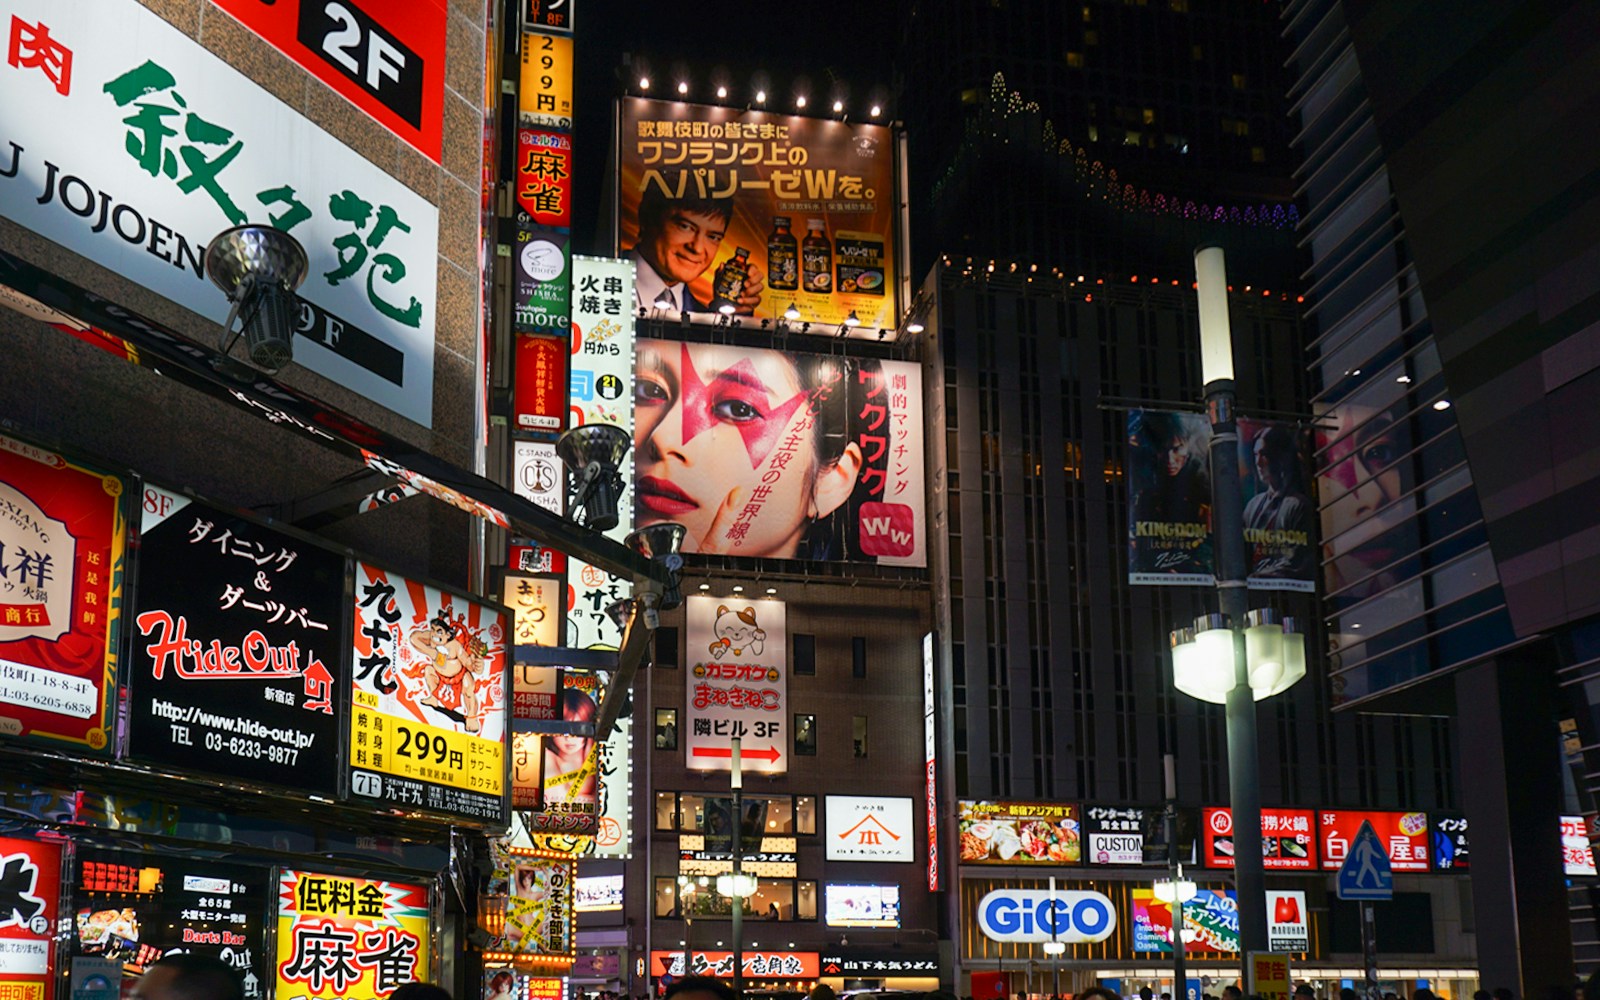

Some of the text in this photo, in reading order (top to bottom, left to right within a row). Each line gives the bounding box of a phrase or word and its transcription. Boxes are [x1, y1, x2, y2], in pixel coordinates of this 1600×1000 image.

[8, 14, 73, 96] 肉
[322, 2, 405, 90] 2F
[537, 36, 556, 111] 299円
[637, 120, 790, 141] 歌舞伎町の皆さまに
[637, 141, 808, 166] ワンランク上の
[522, 151, 568, 215] 麻雀
[638, 168, 876, 200] ヘパリーゼWを。
[517, 231, 532, 241] 5F
[515, 311, 569, 328] more
[584, 342, 621, 356] 円から
[858, 369, 888, 497] ワクワク
[891, 373, 911, 496] 劇的マッチング
[143, 488, 175, 518] 8F
[1135, 521, 1207, 539] KINGDOM
[188, 517, 299, 573] ダイニング
[0, 541, 55, 589] 祥
[253, 570, 273, 592] &
[5, 606, 42, 625] 商行
[219, 583, 330, 632] ダーツバー
[574, 608, 583, 618] 円
[583, 588, 608, 641] サワー
[356, 578, 403, 696] 九十九
[0, 664, 91, 695] 伎町1-18-8-4F
[705, 661, 768, 682] カラオケ
[264, 685, 297, 707] 新宿店
[693, 683, 781, 712] まねきねこ
[151, 698, 316, 749] http://www.hide-out.jp/
[694, 718, 781, 739] 隣ビル 3F
[170, 723, 299, 767] TEL 03-6233-9877
[396, 726, 464, 771] 299円
[469, 742, 501, 759] 生ビール
[470, 759, 492, 772] サワー
[355, 773, 382, 797] 7F
[469, 775, 500, 792] カクテル
[385, 784, 424, 806] 九十九
[535, 814, 595, 829] マドンナ
[1322, 813, 1336, 826] 5F
[1326, 830, 1414, 861] 白屋
[1438, 857, 1453, 869] 4F
[298, 876, 385, 918] 低料金
[985, 897, 1110, 936] GiGO
[1135, 914, 1150, 923] Get
[1153, 923, 1166, 932] the
[182, 928, 247, 945] Darts Bar
[1136, 933, 1167, 943] Gaming
[1137, 941, 1159, 950] Oasis
[284, 925, 416, 993] 麻雀
[843, 960, 938, 971] 山下本気うどん
[1256, 961, 1286, 981] 警告
